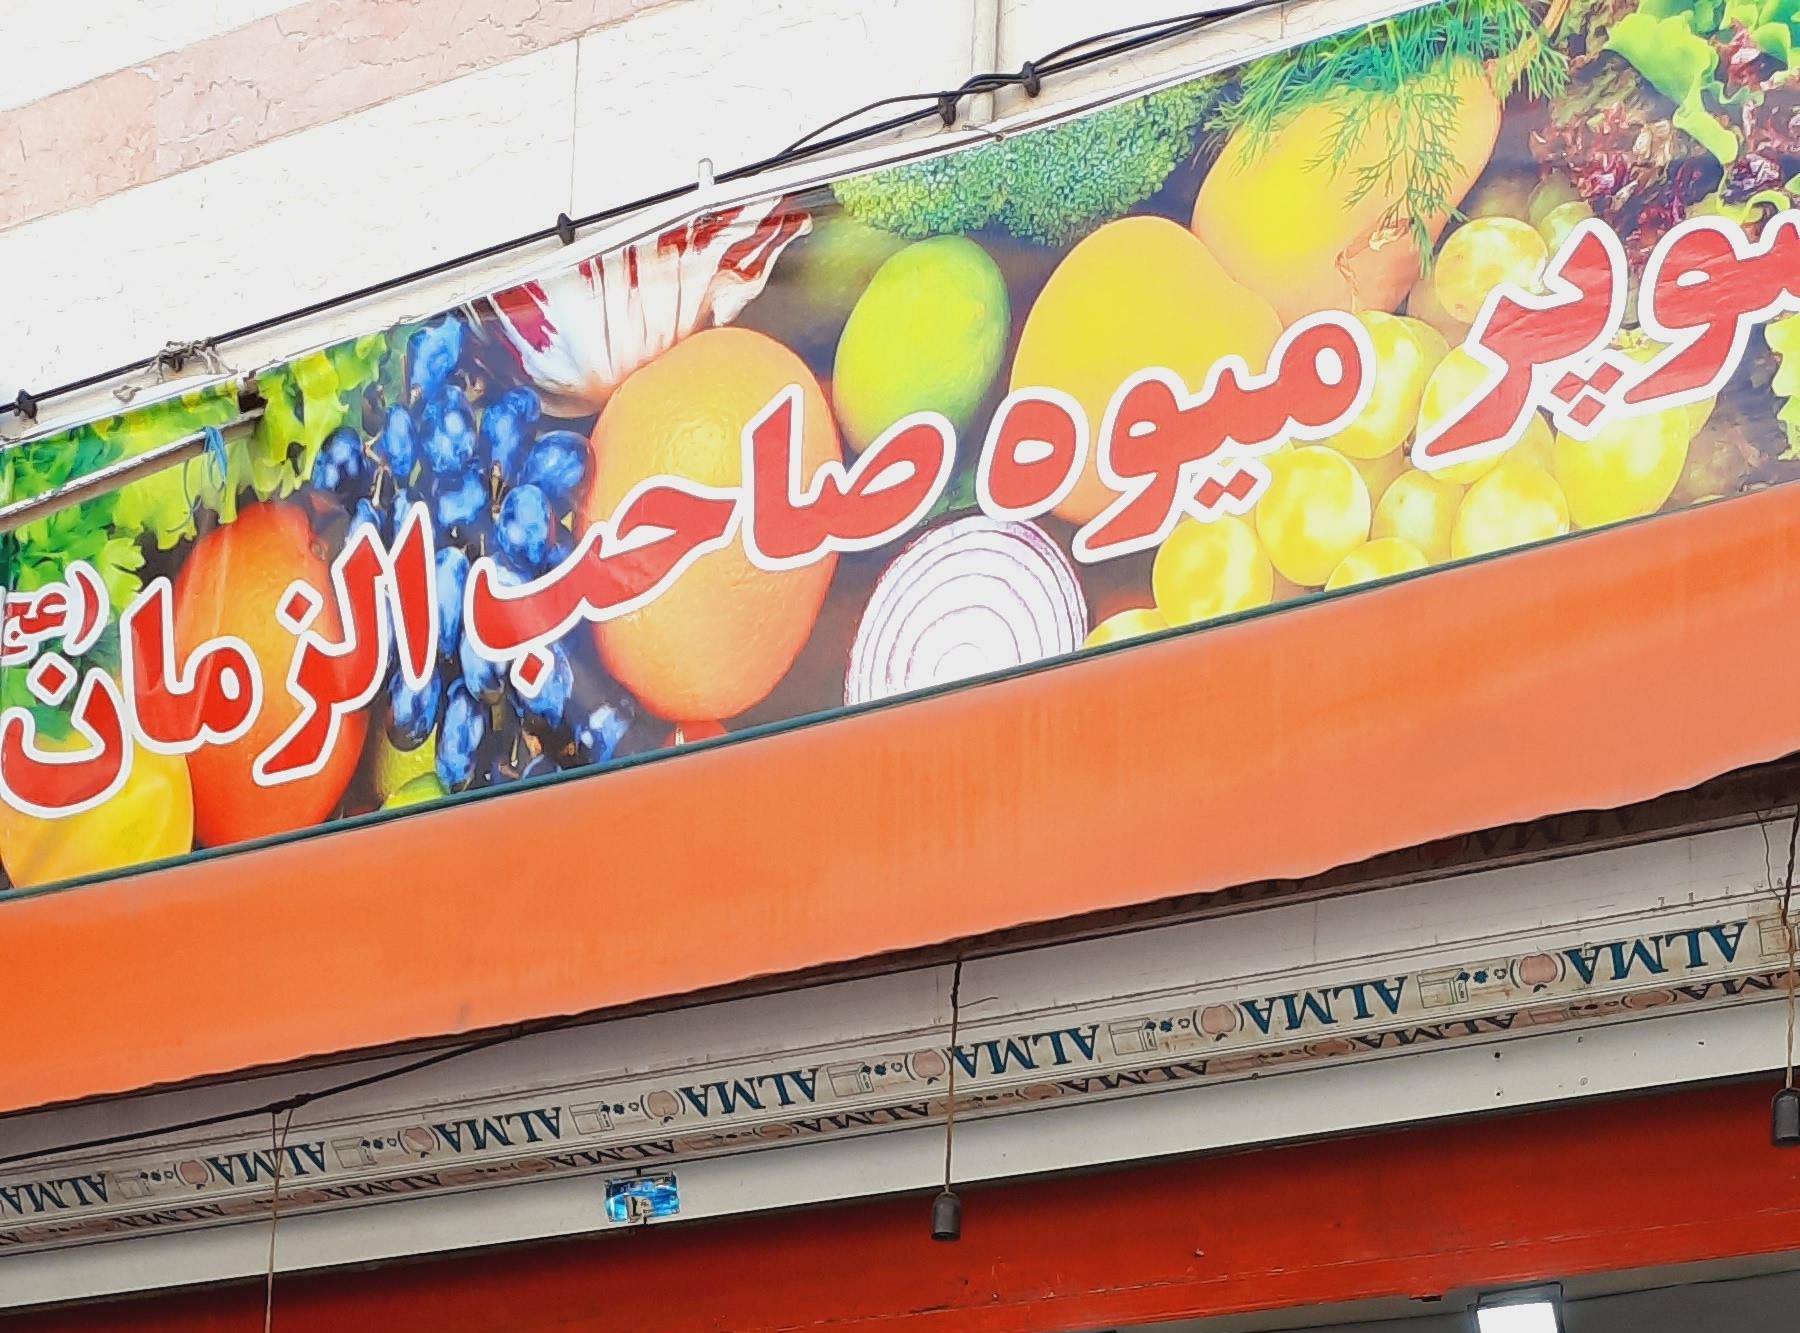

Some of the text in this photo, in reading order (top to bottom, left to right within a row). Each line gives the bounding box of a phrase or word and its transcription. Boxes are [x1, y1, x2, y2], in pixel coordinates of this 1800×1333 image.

[976, 312, 1378, 563] میوه
[464, 383, 956, 697] صاحب
[0, 500, 437, 818] الزمان
[1563, 920, 1748, 985] ALMA
[1239, 975, 1407, 1035] ALMA
[948, 1025, 1099, 1078] ALMA
[678, 1067, 818, 1117] ALMA
[433, 1106, 562, 1154] ALMA
[206, 1141, 325, 1187] ALMA
